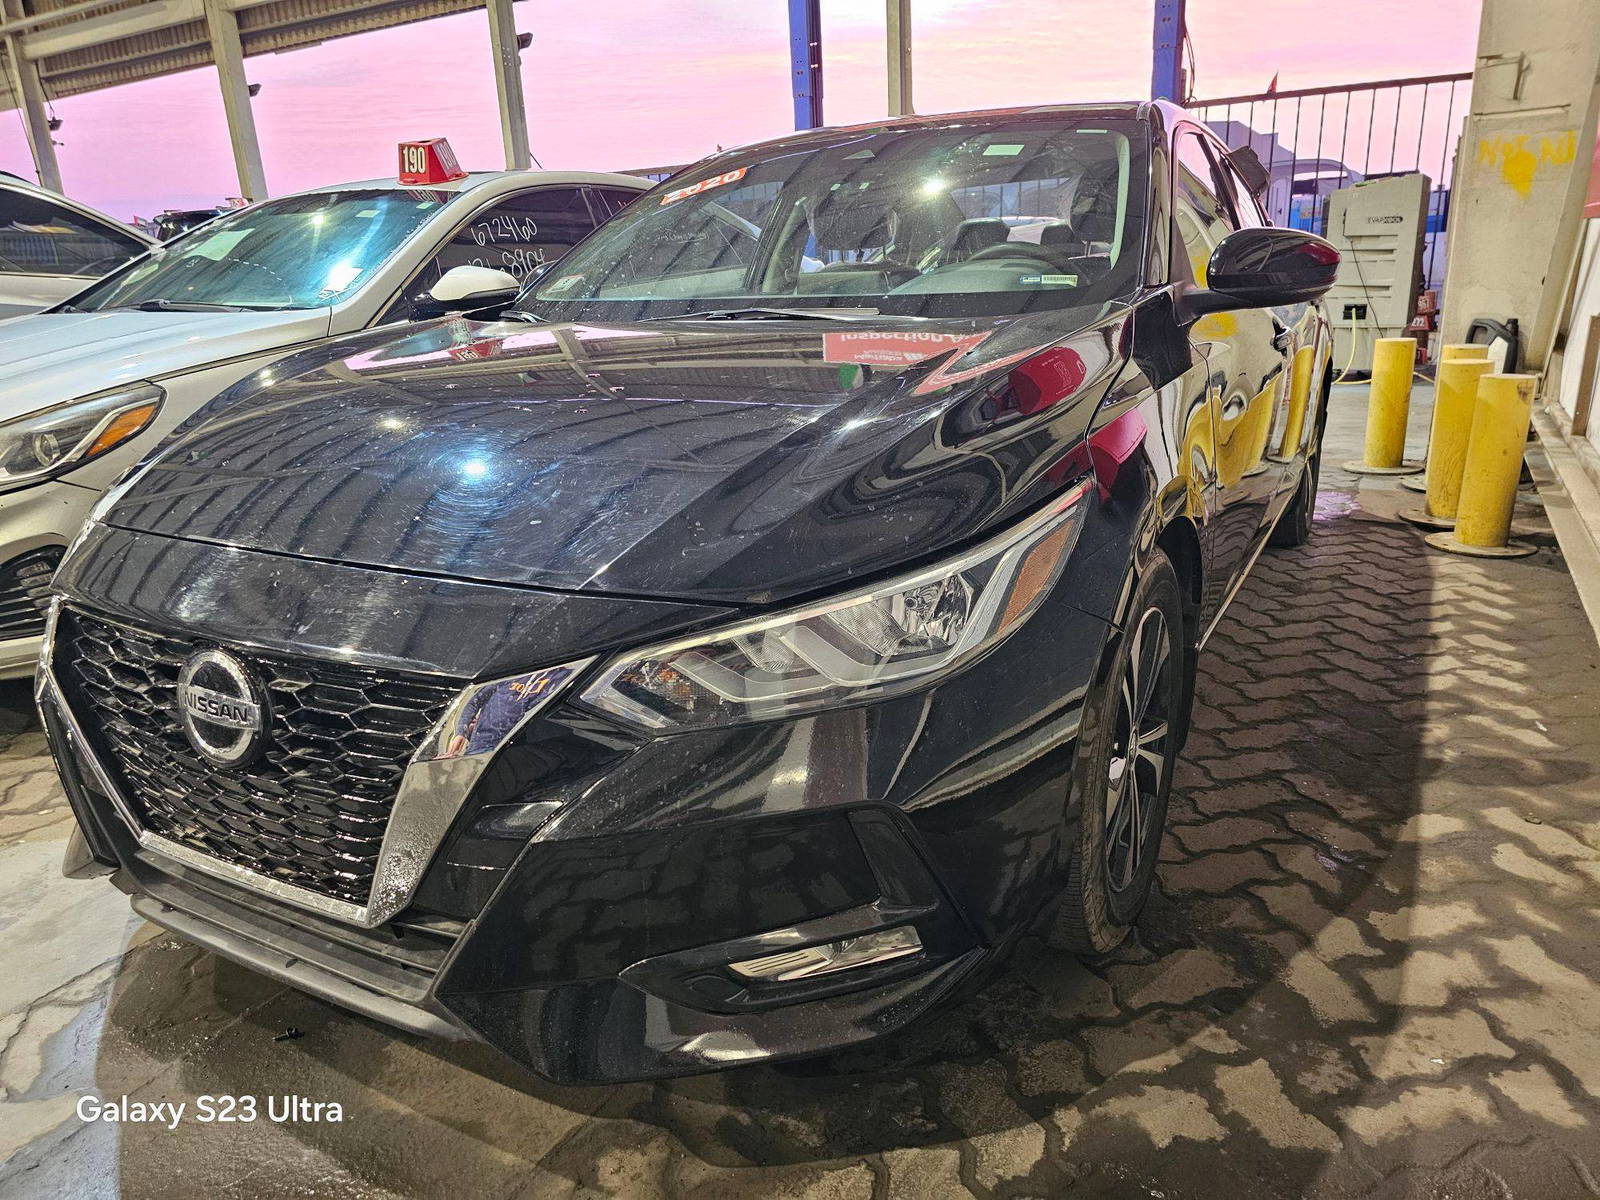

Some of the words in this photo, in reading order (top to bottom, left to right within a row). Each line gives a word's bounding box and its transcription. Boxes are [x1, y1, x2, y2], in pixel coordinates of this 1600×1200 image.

[403, 146, 426, 173] 190
[661, 169, 741, 205] 2020
[470, 216, 538, 246] 672460
[185, 689, 248, 723] NISSAN
